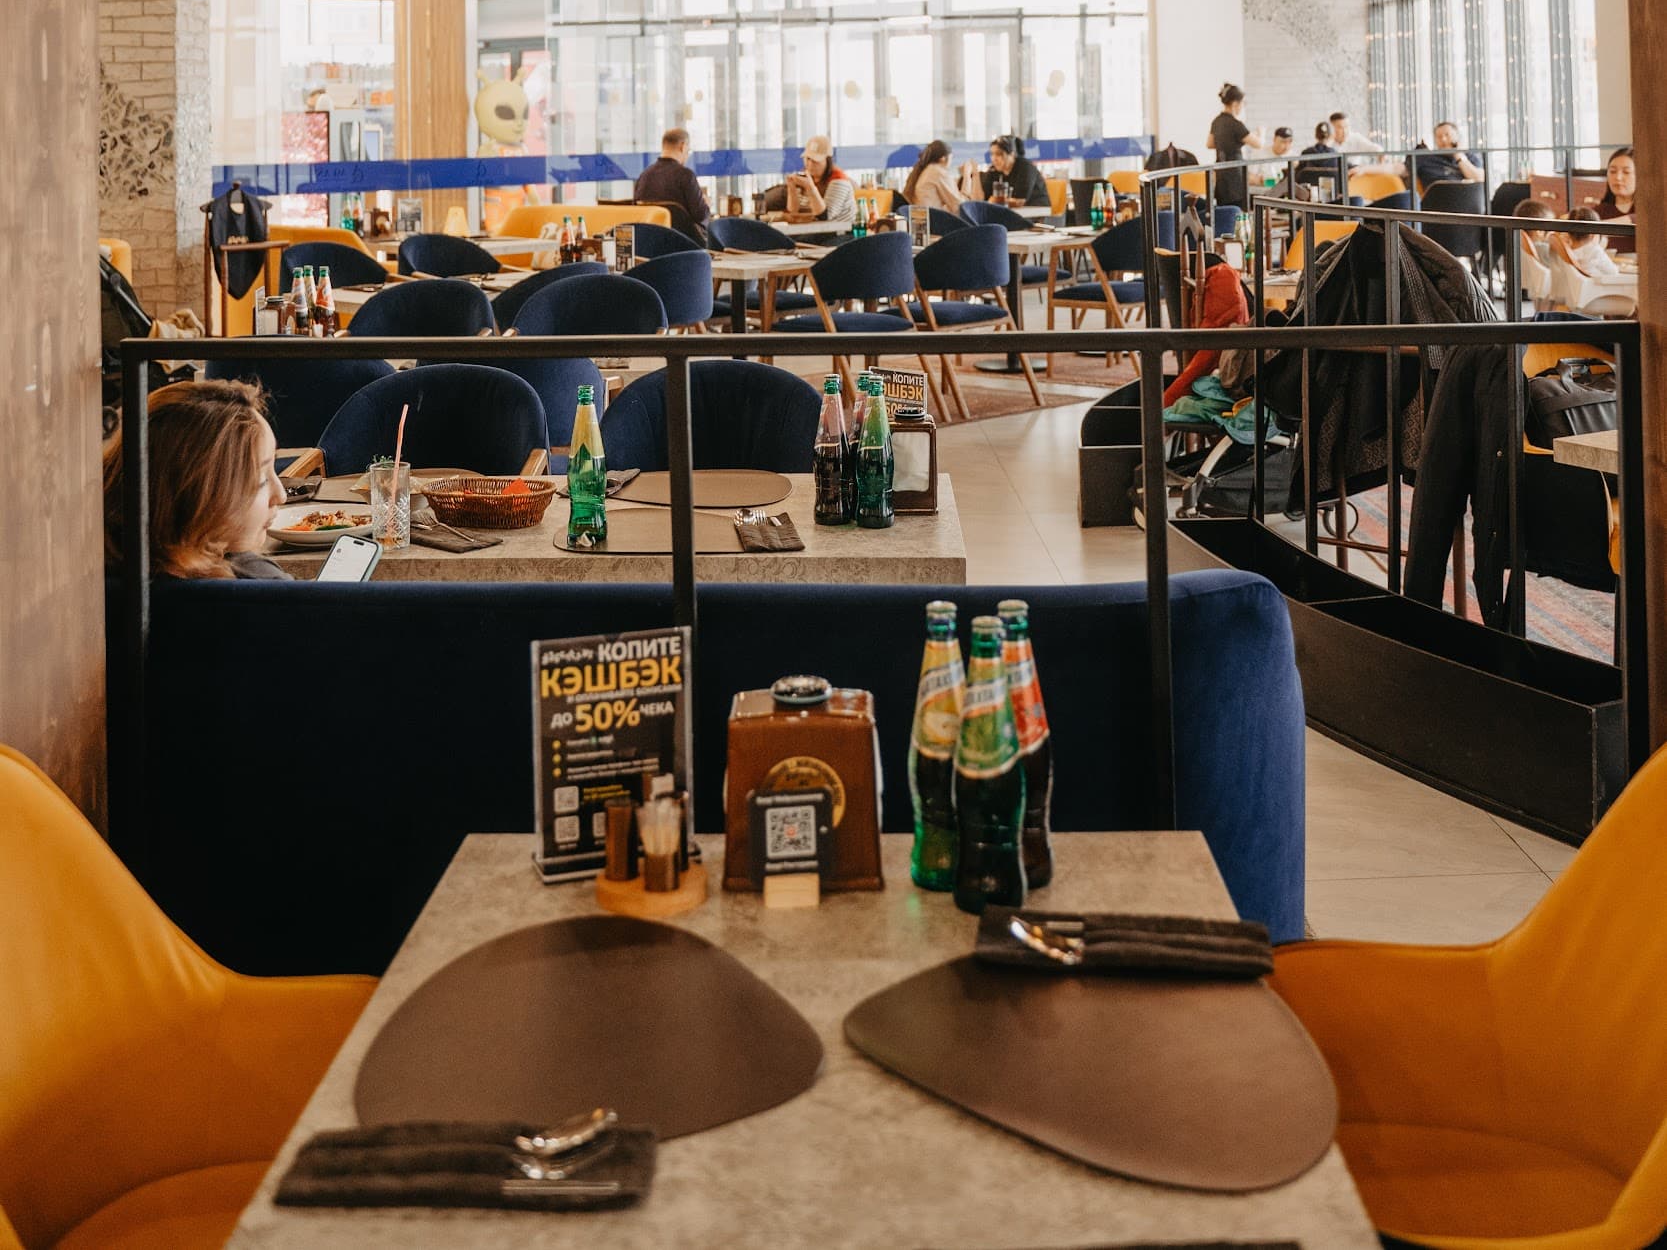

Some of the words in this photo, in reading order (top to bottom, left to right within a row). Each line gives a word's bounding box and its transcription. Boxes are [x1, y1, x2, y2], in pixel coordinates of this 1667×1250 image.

[884, 383, 923, 400] ШБЭК
[893, 374, 924, 386] КОПИТЕ
[598, 637, 682, 661] КОПИТЕ
[540, 656, 682, 698] КЭШБЭК
[551, 712, 573, 729] ДО
[575, 698, 641, 733] 50%
[640, 701, 674, 716] ЧЕКА
